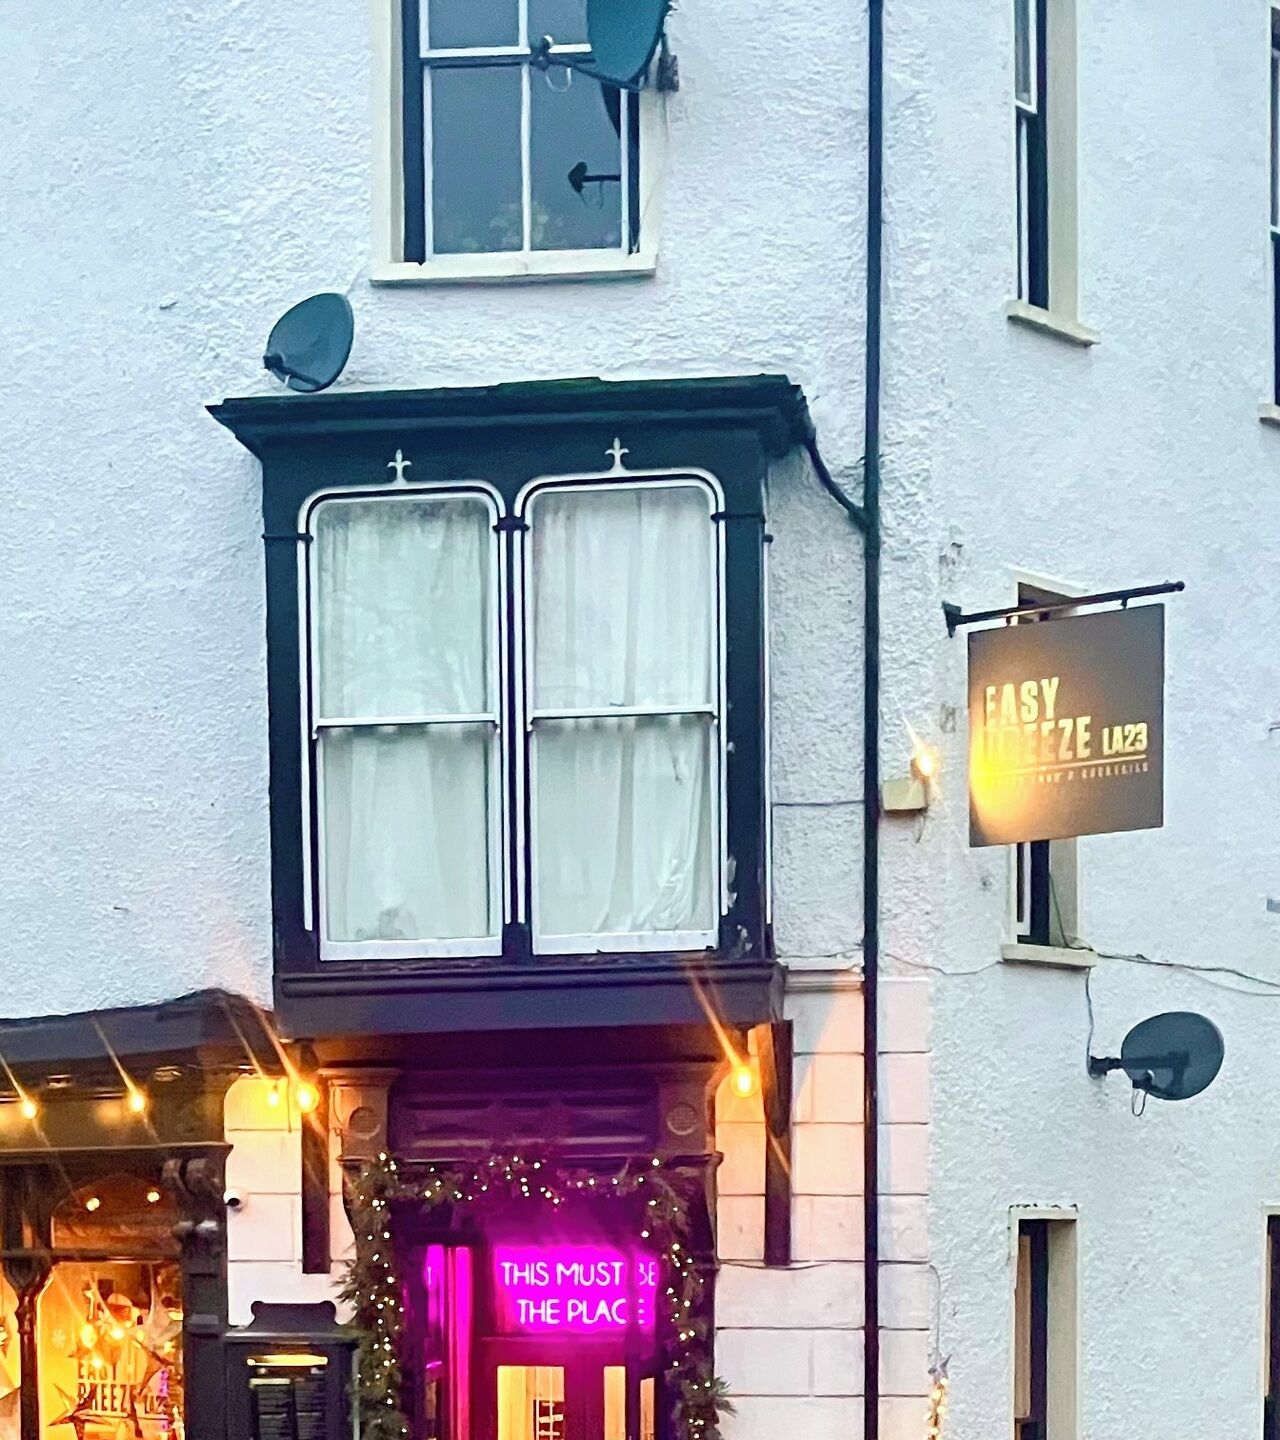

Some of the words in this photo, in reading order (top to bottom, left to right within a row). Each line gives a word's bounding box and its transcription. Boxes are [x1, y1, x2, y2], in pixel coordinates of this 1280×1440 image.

[985, 677, 1060, 727] EASY
[985, 715, 1092, 770] EEZE
[1102, 722, 1148, 755] LA23
[500, 1261, 550, 1286] THIS
[556, 1261, 624, 1286] MUST
[517, 1298, 560, 1325] THE
